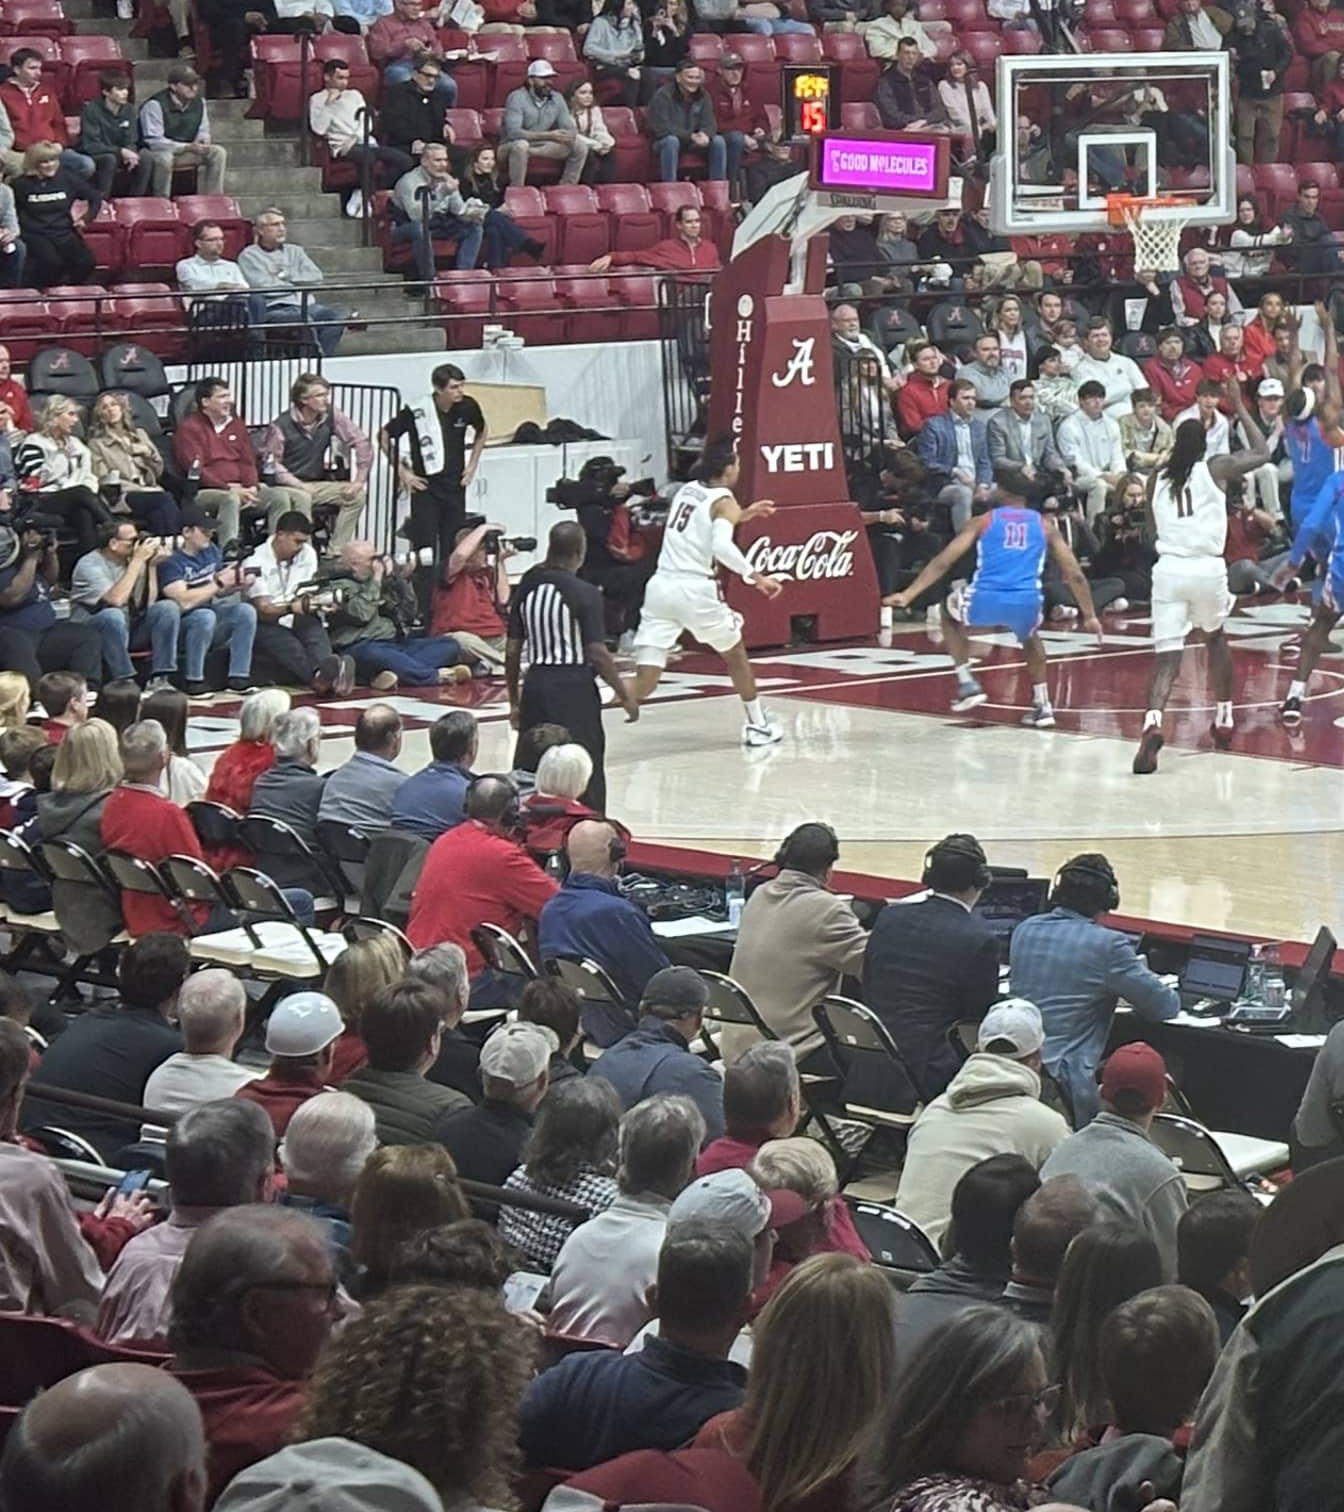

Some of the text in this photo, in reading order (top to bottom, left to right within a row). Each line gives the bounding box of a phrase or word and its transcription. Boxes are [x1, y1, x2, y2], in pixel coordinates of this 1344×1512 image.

[802, 101, 827, 133] 15
[840, 153, 868, 172] GOOD
[870, 155, 928, 176] MOLECULES
[772, 337, 815, 386] A
[761, 443, 834, 473] YETI
[668, 501, 696, 534] 15
[1004, 522, 1027, 550] 11
[744, 530, 857, 585] Coca-Cola
